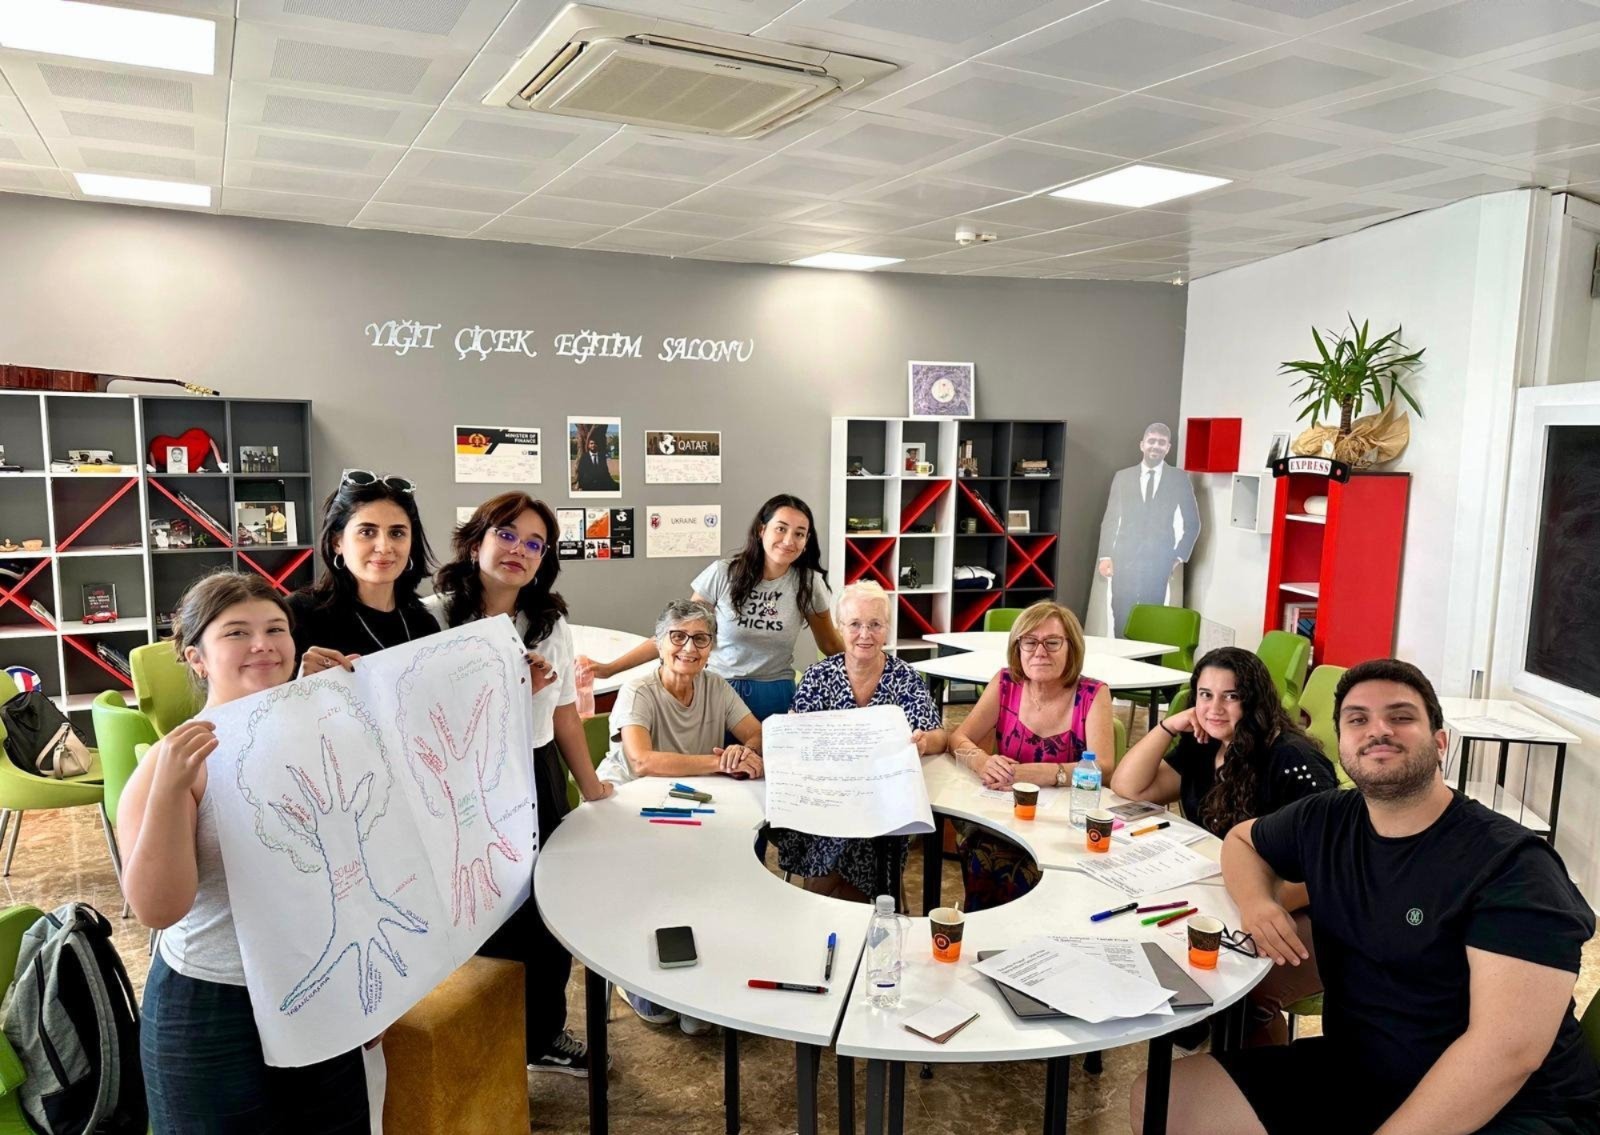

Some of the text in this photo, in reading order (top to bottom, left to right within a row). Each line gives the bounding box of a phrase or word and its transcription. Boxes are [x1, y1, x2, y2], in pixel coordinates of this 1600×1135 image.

[365, 319, 754, 365] YİĞİT ÇİÇEK EĞİTİM SALONU
[678, 440, 708, 451] QATAR
[1290, 460, 1330, 473] EXPRESS
[671, 517, 697, 525] UKRAINE
[737, 617, 783, 631] HICKS
